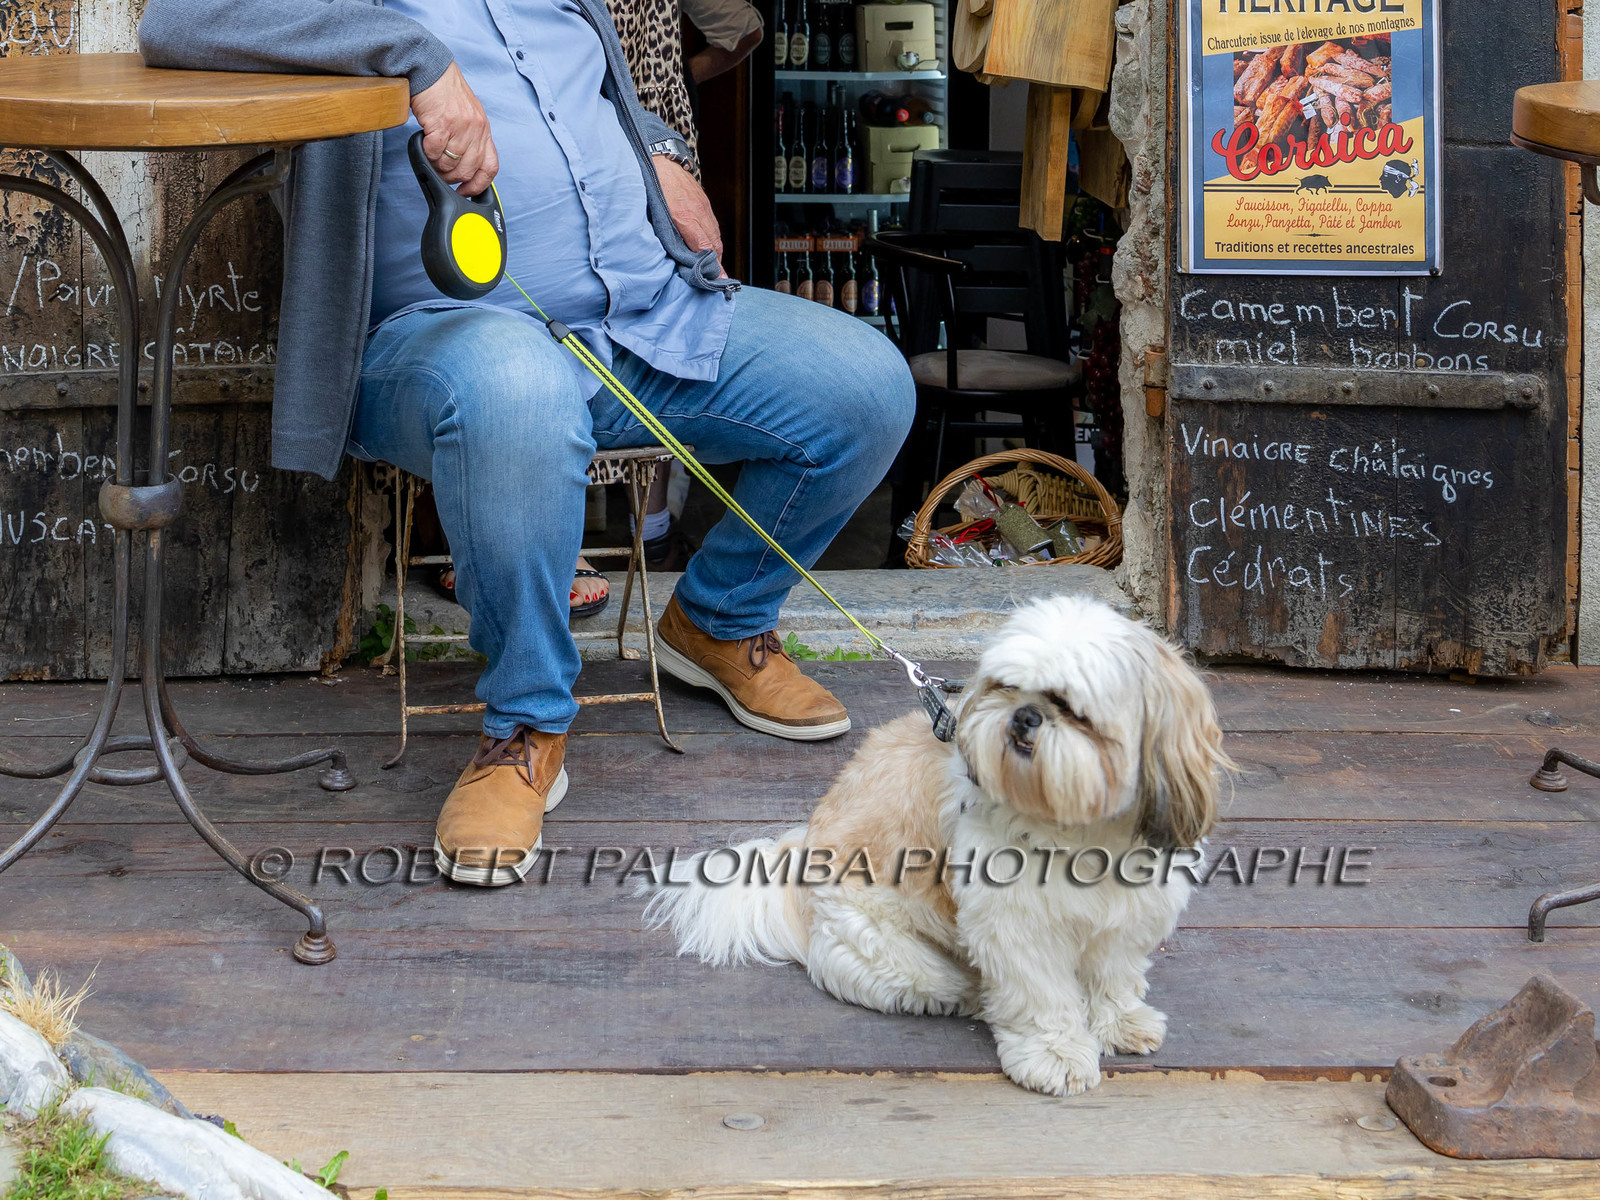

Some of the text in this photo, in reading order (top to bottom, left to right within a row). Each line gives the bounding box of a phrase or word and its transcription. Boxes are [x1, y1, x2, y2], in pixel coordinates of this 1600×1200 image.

[1207, 31, 1258, 51] Charcuterie
[1259, 31, 1282, 45] issue
[1284, 29, 1295, 42] de
[1336, 22, 1347, 35] de
[1349, 23, 1365, 35] nos
[1367, 16, 1416, 32] montagnes
[1211, 111, 1414, 182] Corsica
[1319, 214, 1343, 229] Pâté
[1345, 216, 1356, 229] et
[1355, 196, 1393, 216] Coppa
[1215, 241, 1415, 255] Traditions et recettes ancestrales
[1216, 328, 1489, 372] miel bonbons
[1187, 544, 1354, 603] Cédrats
